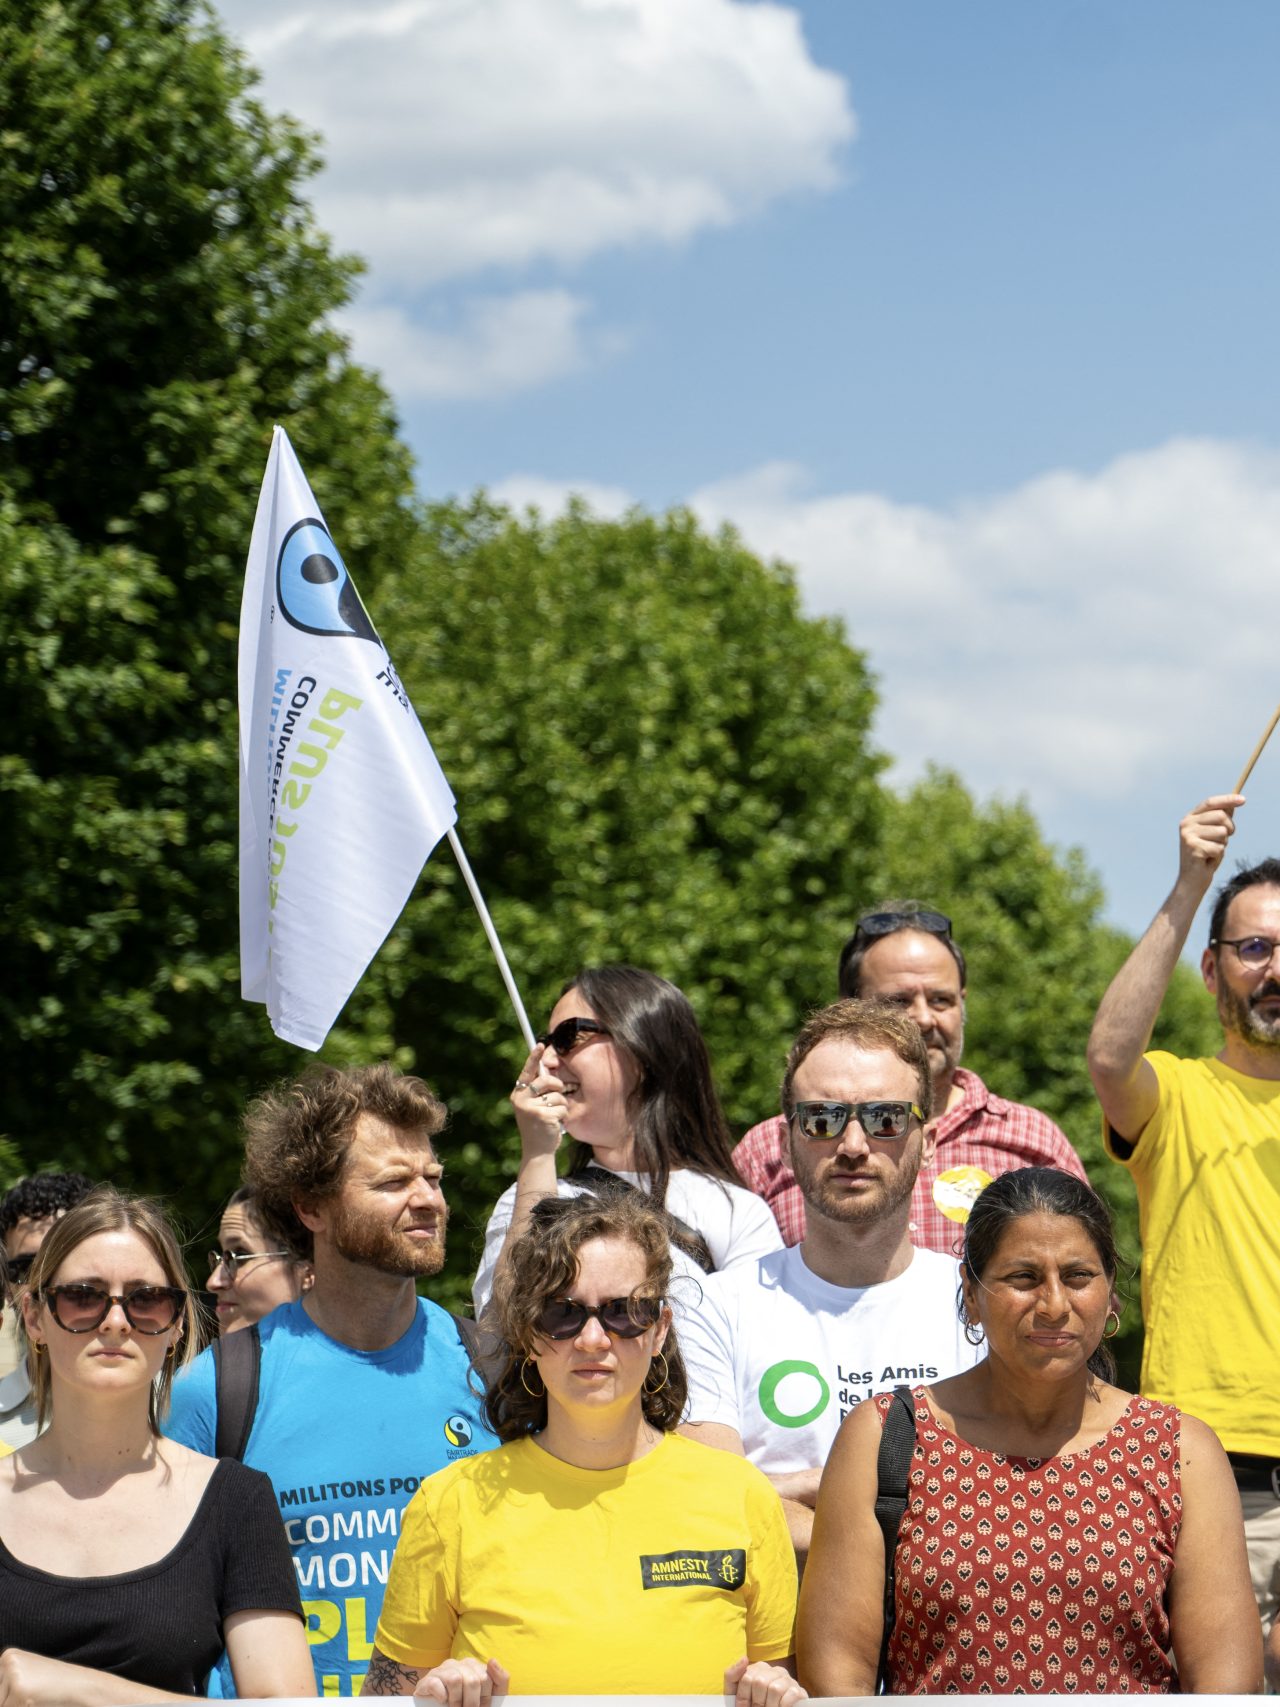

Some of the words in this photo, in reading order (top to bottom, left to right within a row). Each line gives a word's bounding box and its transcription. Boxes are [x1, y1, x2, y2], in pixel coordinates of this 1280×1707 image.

[837, 1365, 873, 1384] Les
[880, 1363, 939, 1382] Amis
[839, 1388, 861, 1406] de
[280, 1478, 386, 1508] MILITONS
[652, 1559, 709, 1574] AMNESTY
[652, 1572, 712, 1582] INTERNATIONAL
